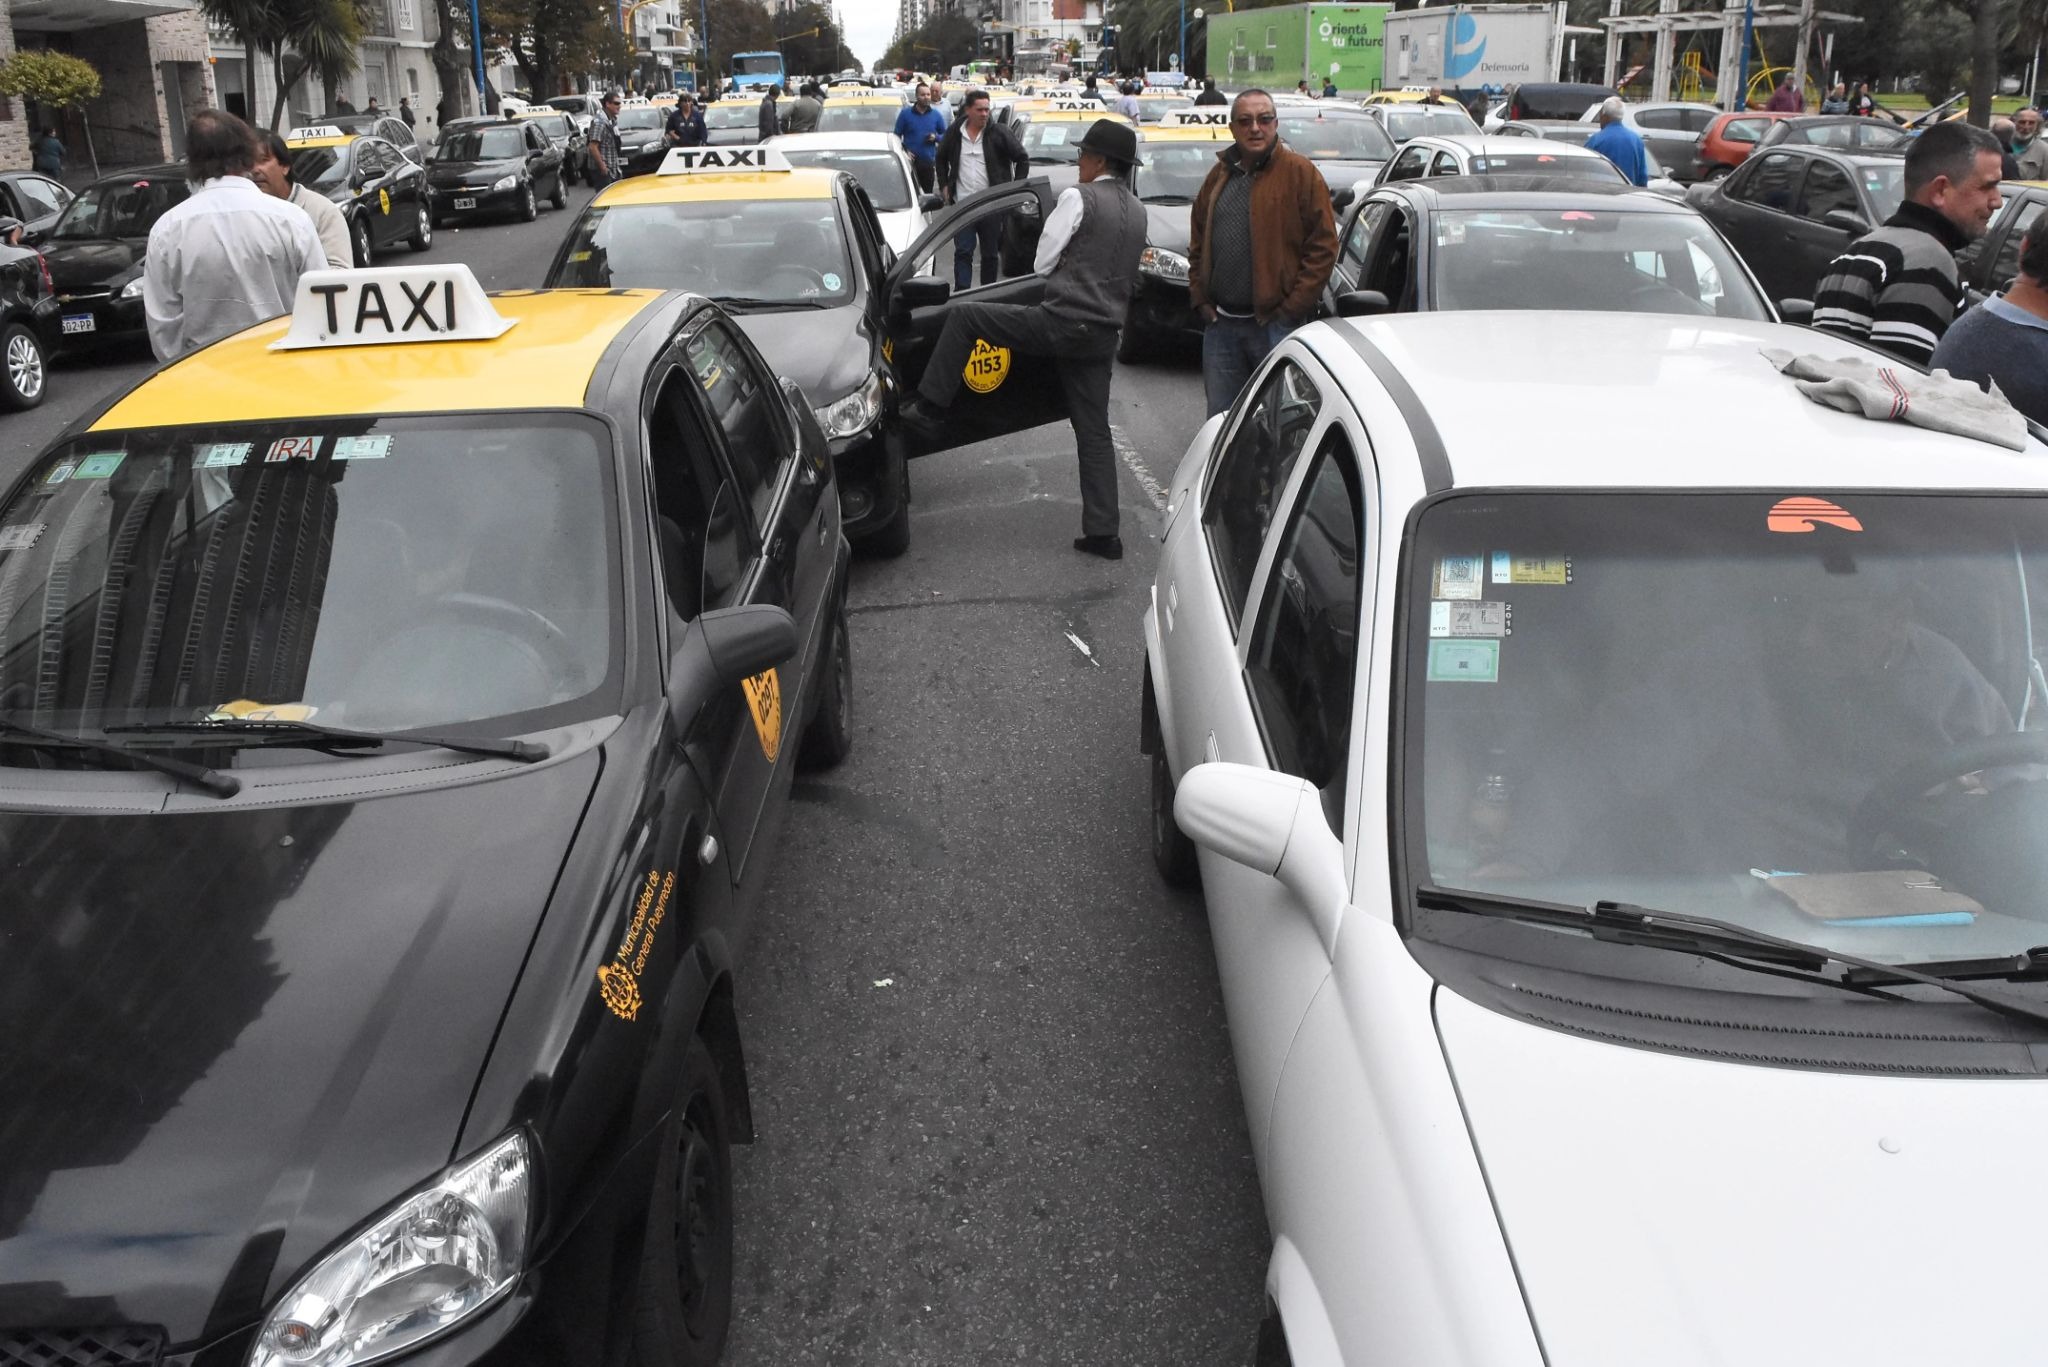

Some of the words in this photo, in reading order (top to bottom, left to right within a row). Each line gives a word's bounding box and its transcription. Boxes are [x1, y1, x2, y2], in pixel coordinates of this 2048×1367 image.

[1332, 37, 1345, 47] tu
[1175, 114, 1227, 125] TAXI
[301, 127, 326, 138] TAXI
[677, 149, 766, 169] TAXI
[310, 280, 456, 335] TAXI
[971, 355, 1002, 376] 1153
[617, 882, 655, 963] Municipalidad
[649, 870, 660, 888] de
[631, 927, 655, 976] General
